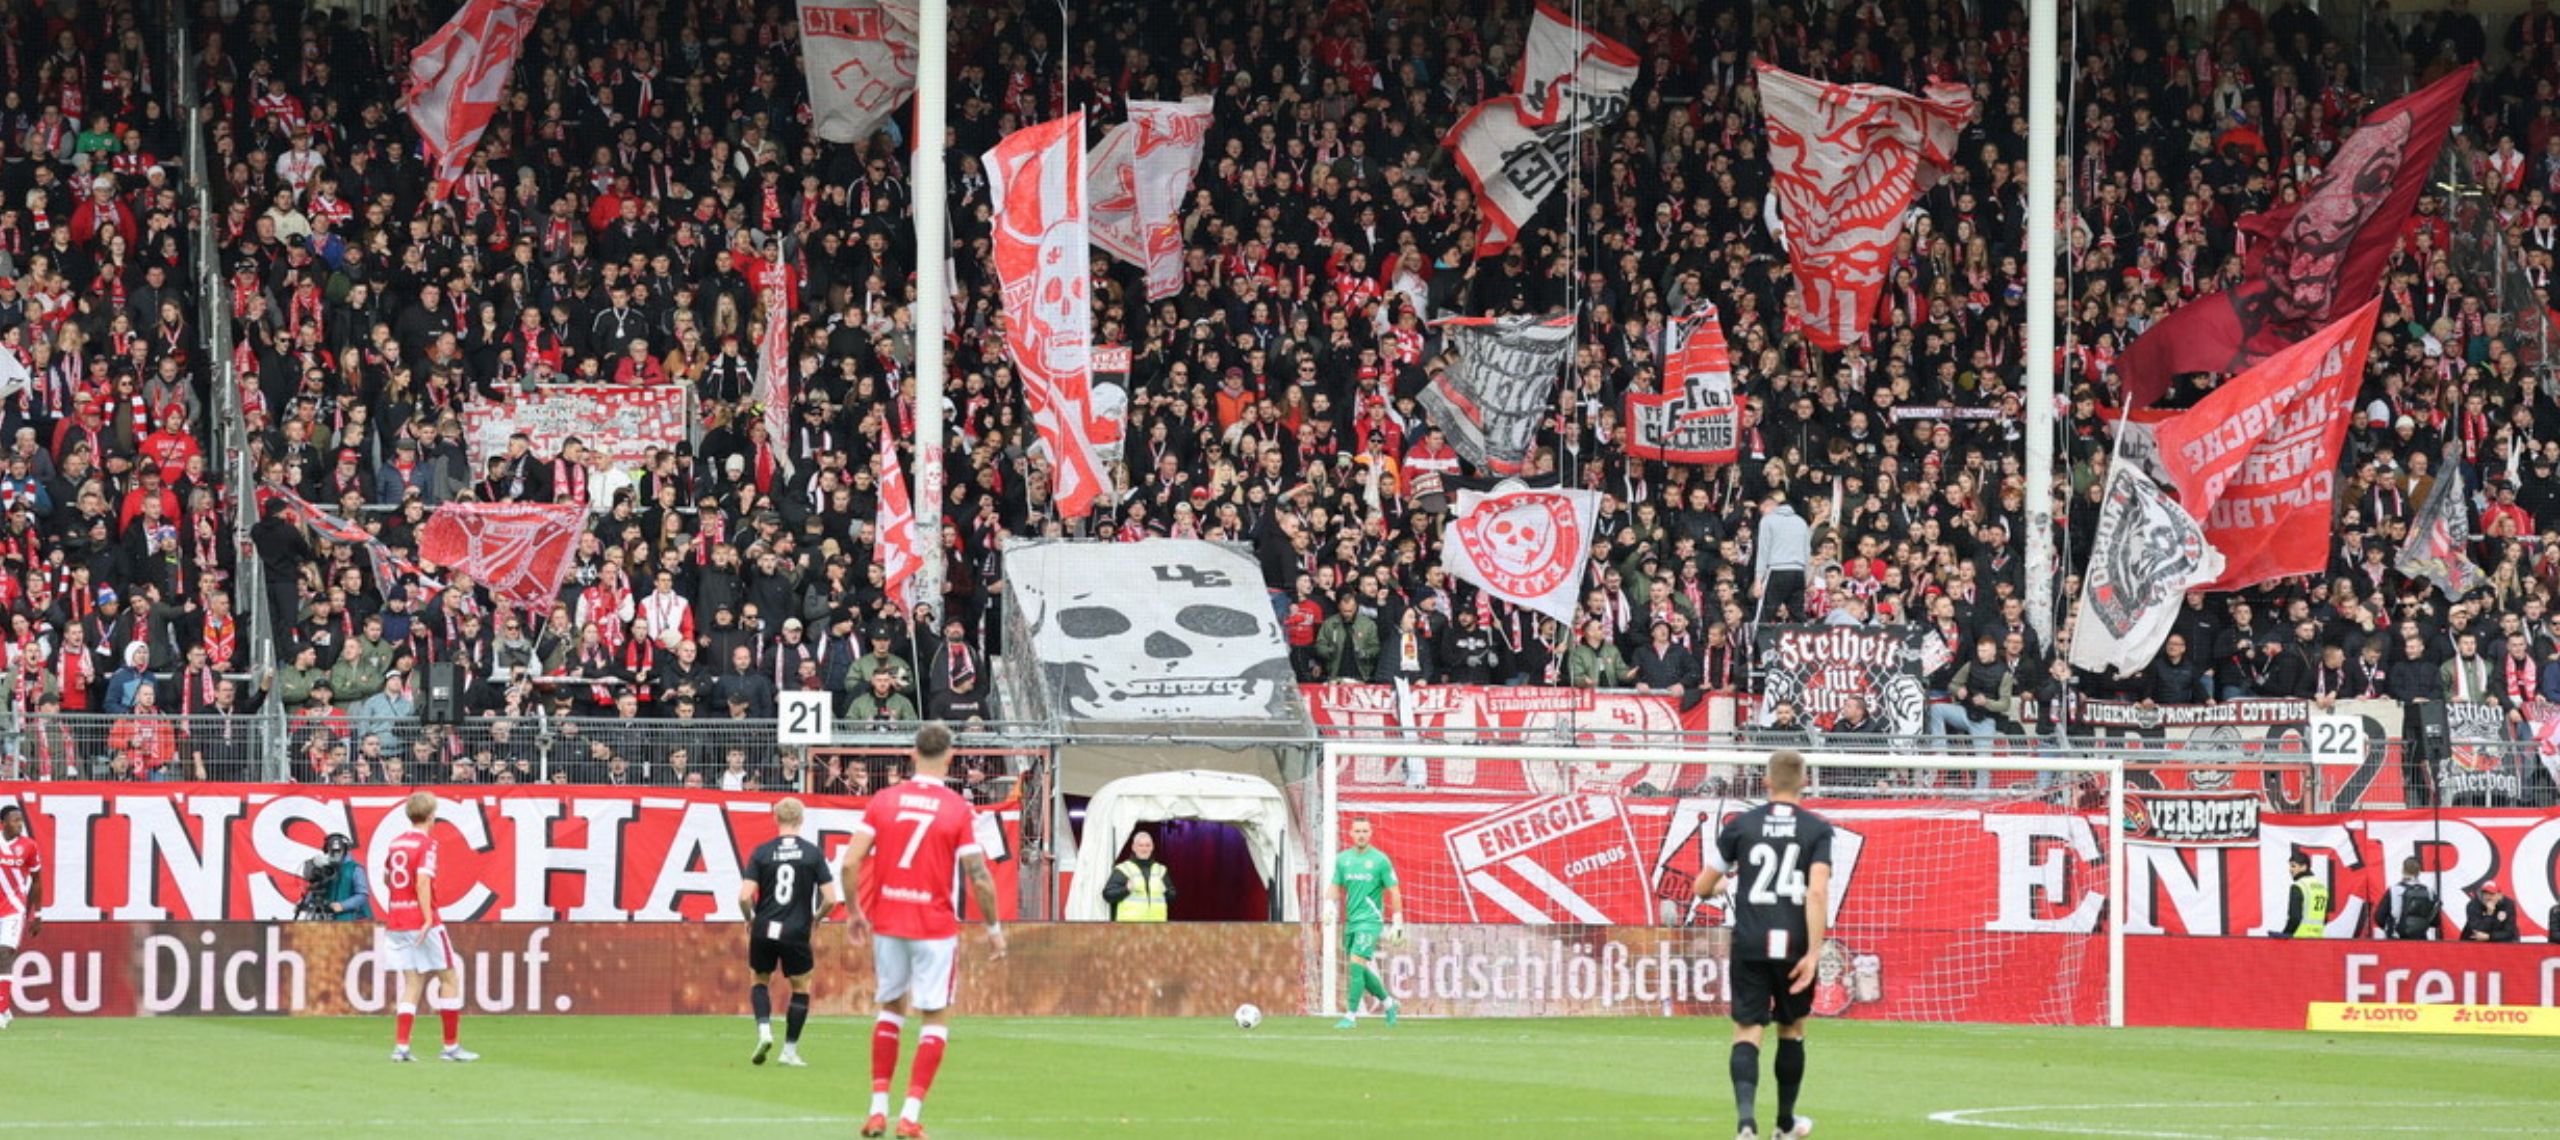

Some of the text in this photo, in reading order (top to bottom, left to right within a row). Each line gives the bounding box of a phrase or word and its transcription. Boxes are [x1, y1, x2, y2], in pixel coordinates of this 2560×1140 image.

[1780, 627, 1899, 671] Freiheit
[1822, 665, 1862, 693] für
[789, 701, 823, 733] 21
[1803, 686, 1878, 718] Ultrs
[2240, 698, 2306, 719] COTTBUS
[2318, 723, 2358, 755] 22
[1477, 795, 1595, 858] ENERGIE
[2146, 799, 2258, 832] VERBOTEN
[896, 811, 935, 869] 7
[391, 850, 410, 889] 8
[1564, 845, 1627, 878] COTTBUS
[1748, 842, 1806, 905] 24
[775, 863, 795, 906] 8
[143, 926, 306, 1013] Dich
[344, 927, 573, 1013] dauf.
[2364, 1008, 2418, 1022] LOTTO
[2475, 1010, 2528, 1024] LOTTO
